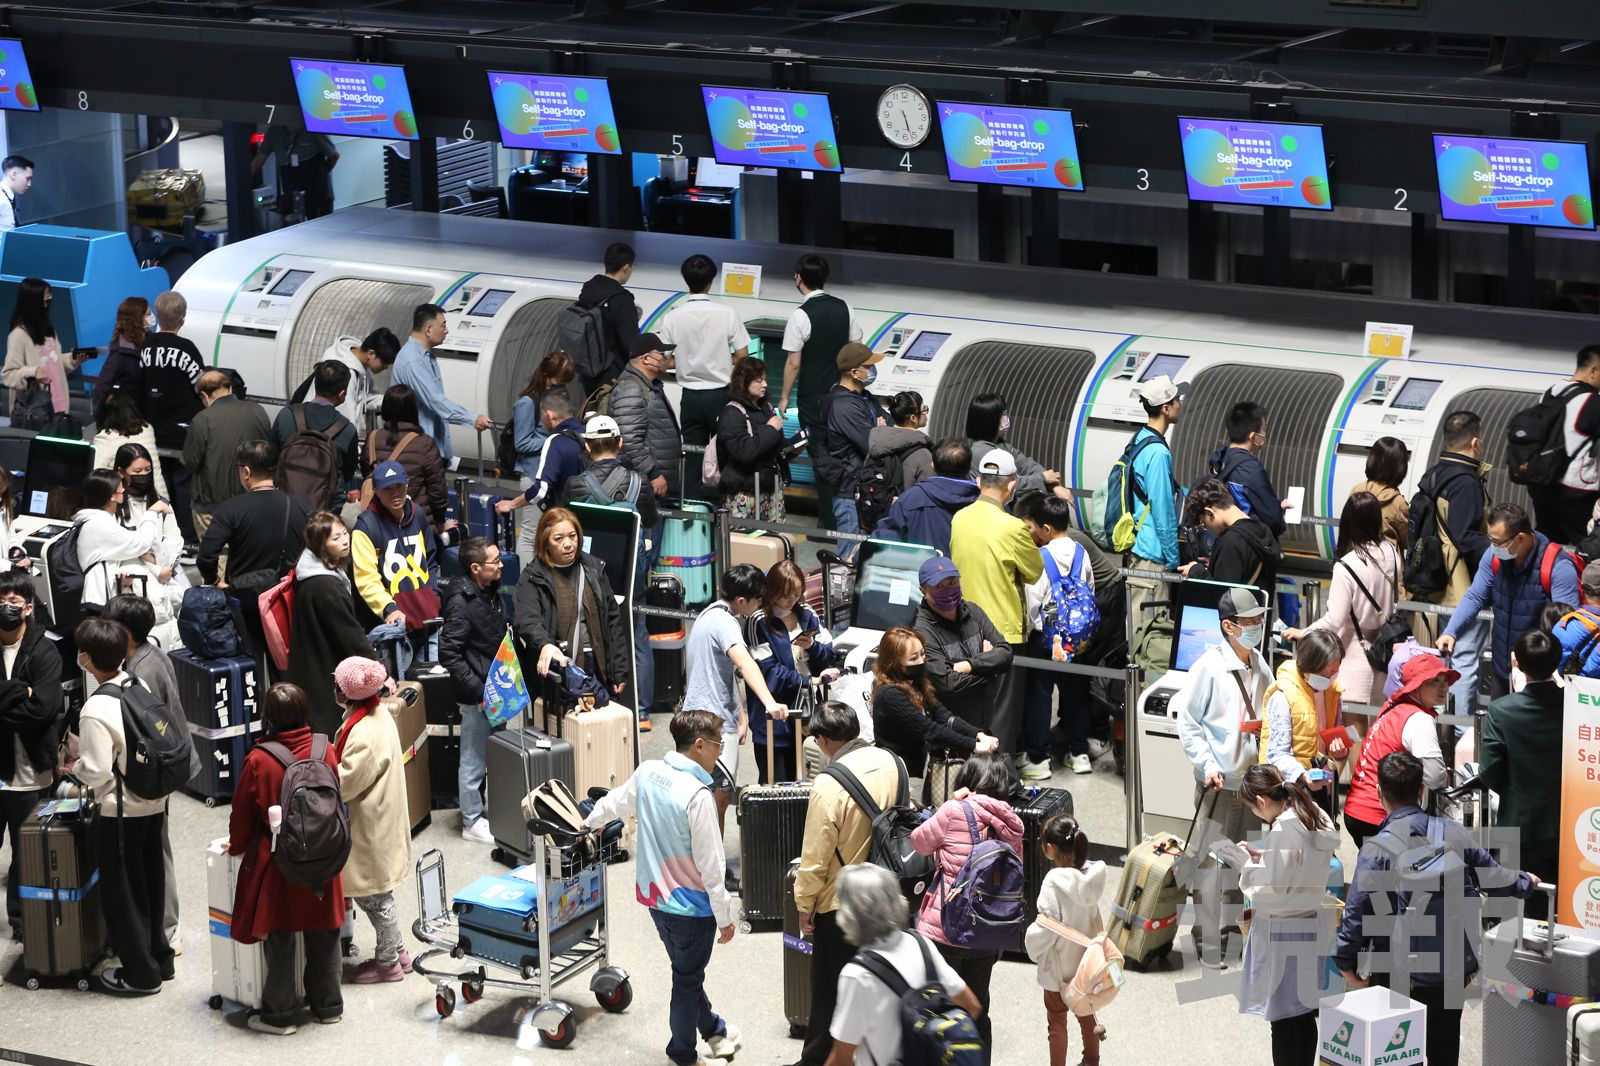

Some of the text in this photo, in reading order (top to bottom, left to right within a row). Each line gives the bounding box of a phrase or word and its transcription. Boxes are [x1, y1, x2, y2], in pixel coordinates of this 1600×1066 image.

[78, 91, 88, 110] 8
[324, 89, 384, 104] Self-bag-drop
[265, 105, 275, 124] 7
[522, 103, 586, 118] Self-bag-drop
[462, 120, 474, 140] 6
[737, 118, 804, 134] Self-bag-drop
[672, 135, 683, 156] 5
[974, 135, 1045, 152] Self-bag-drop
[900, 152, 912, 172] 4
[1216, 152, 1292, 169] Self-bag-drop
[1137, 168, 1149, 190] 3
[1473, 170, 1553, 188] Self-bag-drop
[1394, 188, 1407, 210] 2
[638, 606, 658, 614] Taoyuan
[659, 609, 689, 618] International
[1323, 1042, 1342, 1057] EVA
[1344, 1050, 1362, 1065] AIR
[1374, 1048, 1420, 1066] EVA AIR
